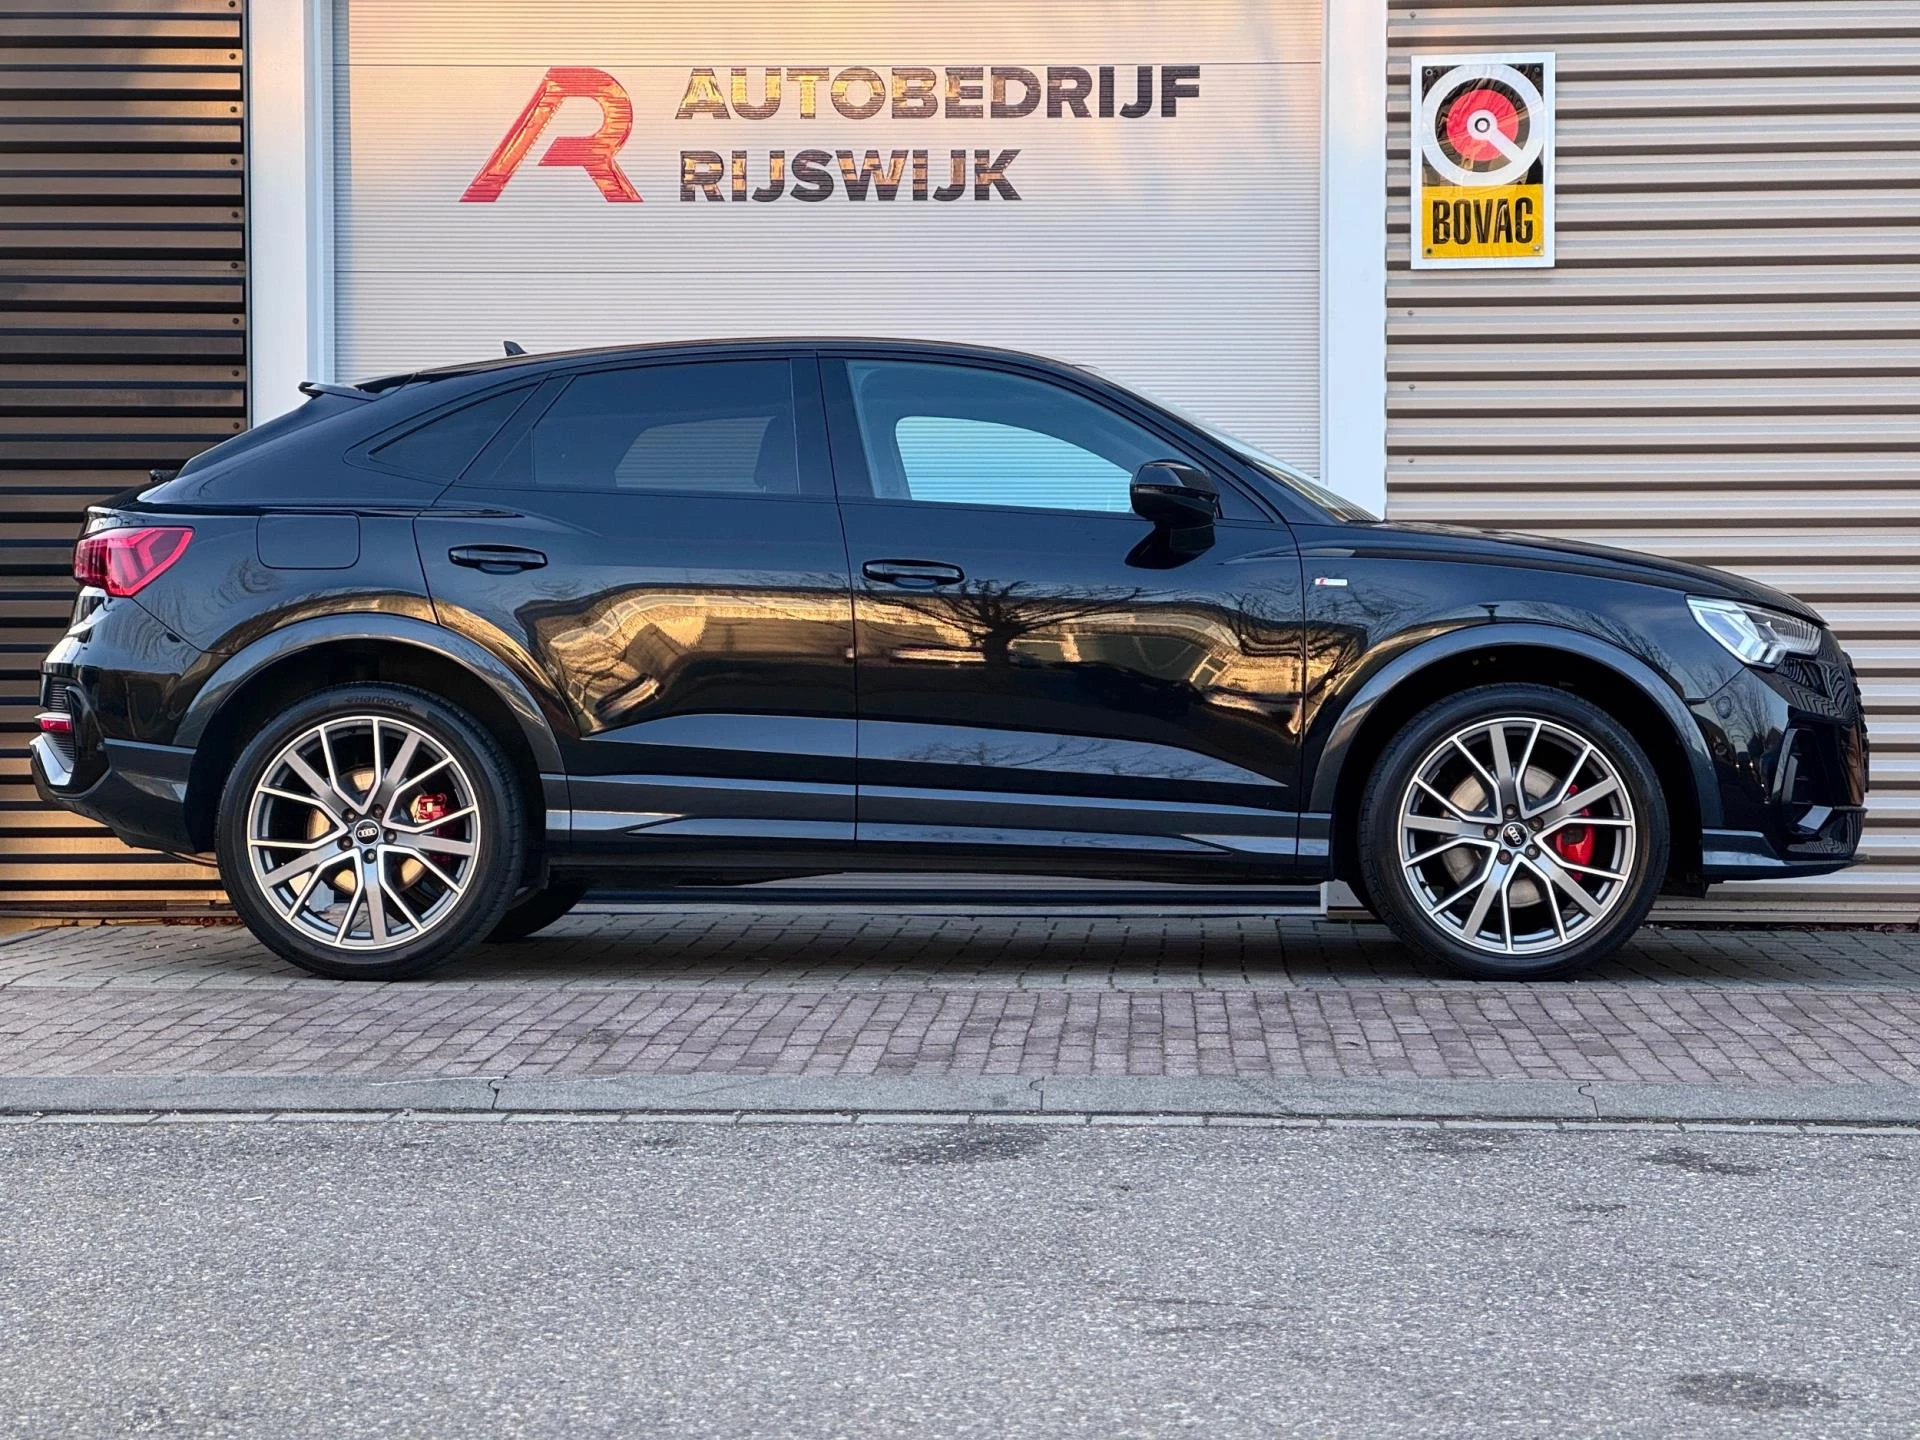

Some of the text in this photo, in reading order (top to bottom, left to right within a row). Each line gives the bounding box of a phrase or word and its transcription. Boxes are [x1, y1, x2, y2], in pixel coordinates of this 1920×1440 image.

[675, 65, 1201, 120] AUTOBEDRIJF
[679, 149, 1022, 202] RIJSWIJK
[1432, 197, 1534, 246] BOVAG
